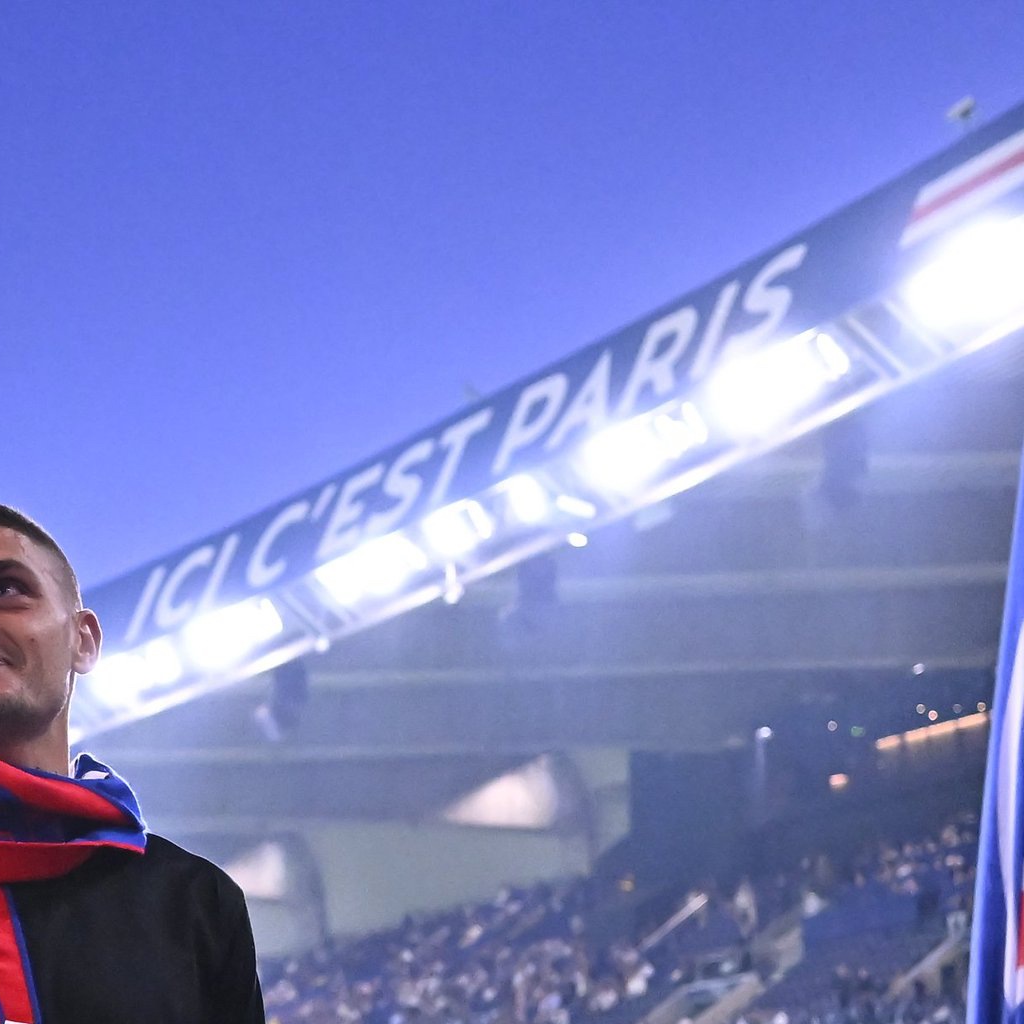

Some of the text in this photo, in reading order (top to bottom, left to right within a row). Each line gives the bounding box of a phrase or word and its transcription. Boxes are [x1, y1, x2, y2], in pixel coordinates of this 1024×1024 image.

[125, 243, 808, 642] ICI C'EST PARIS
